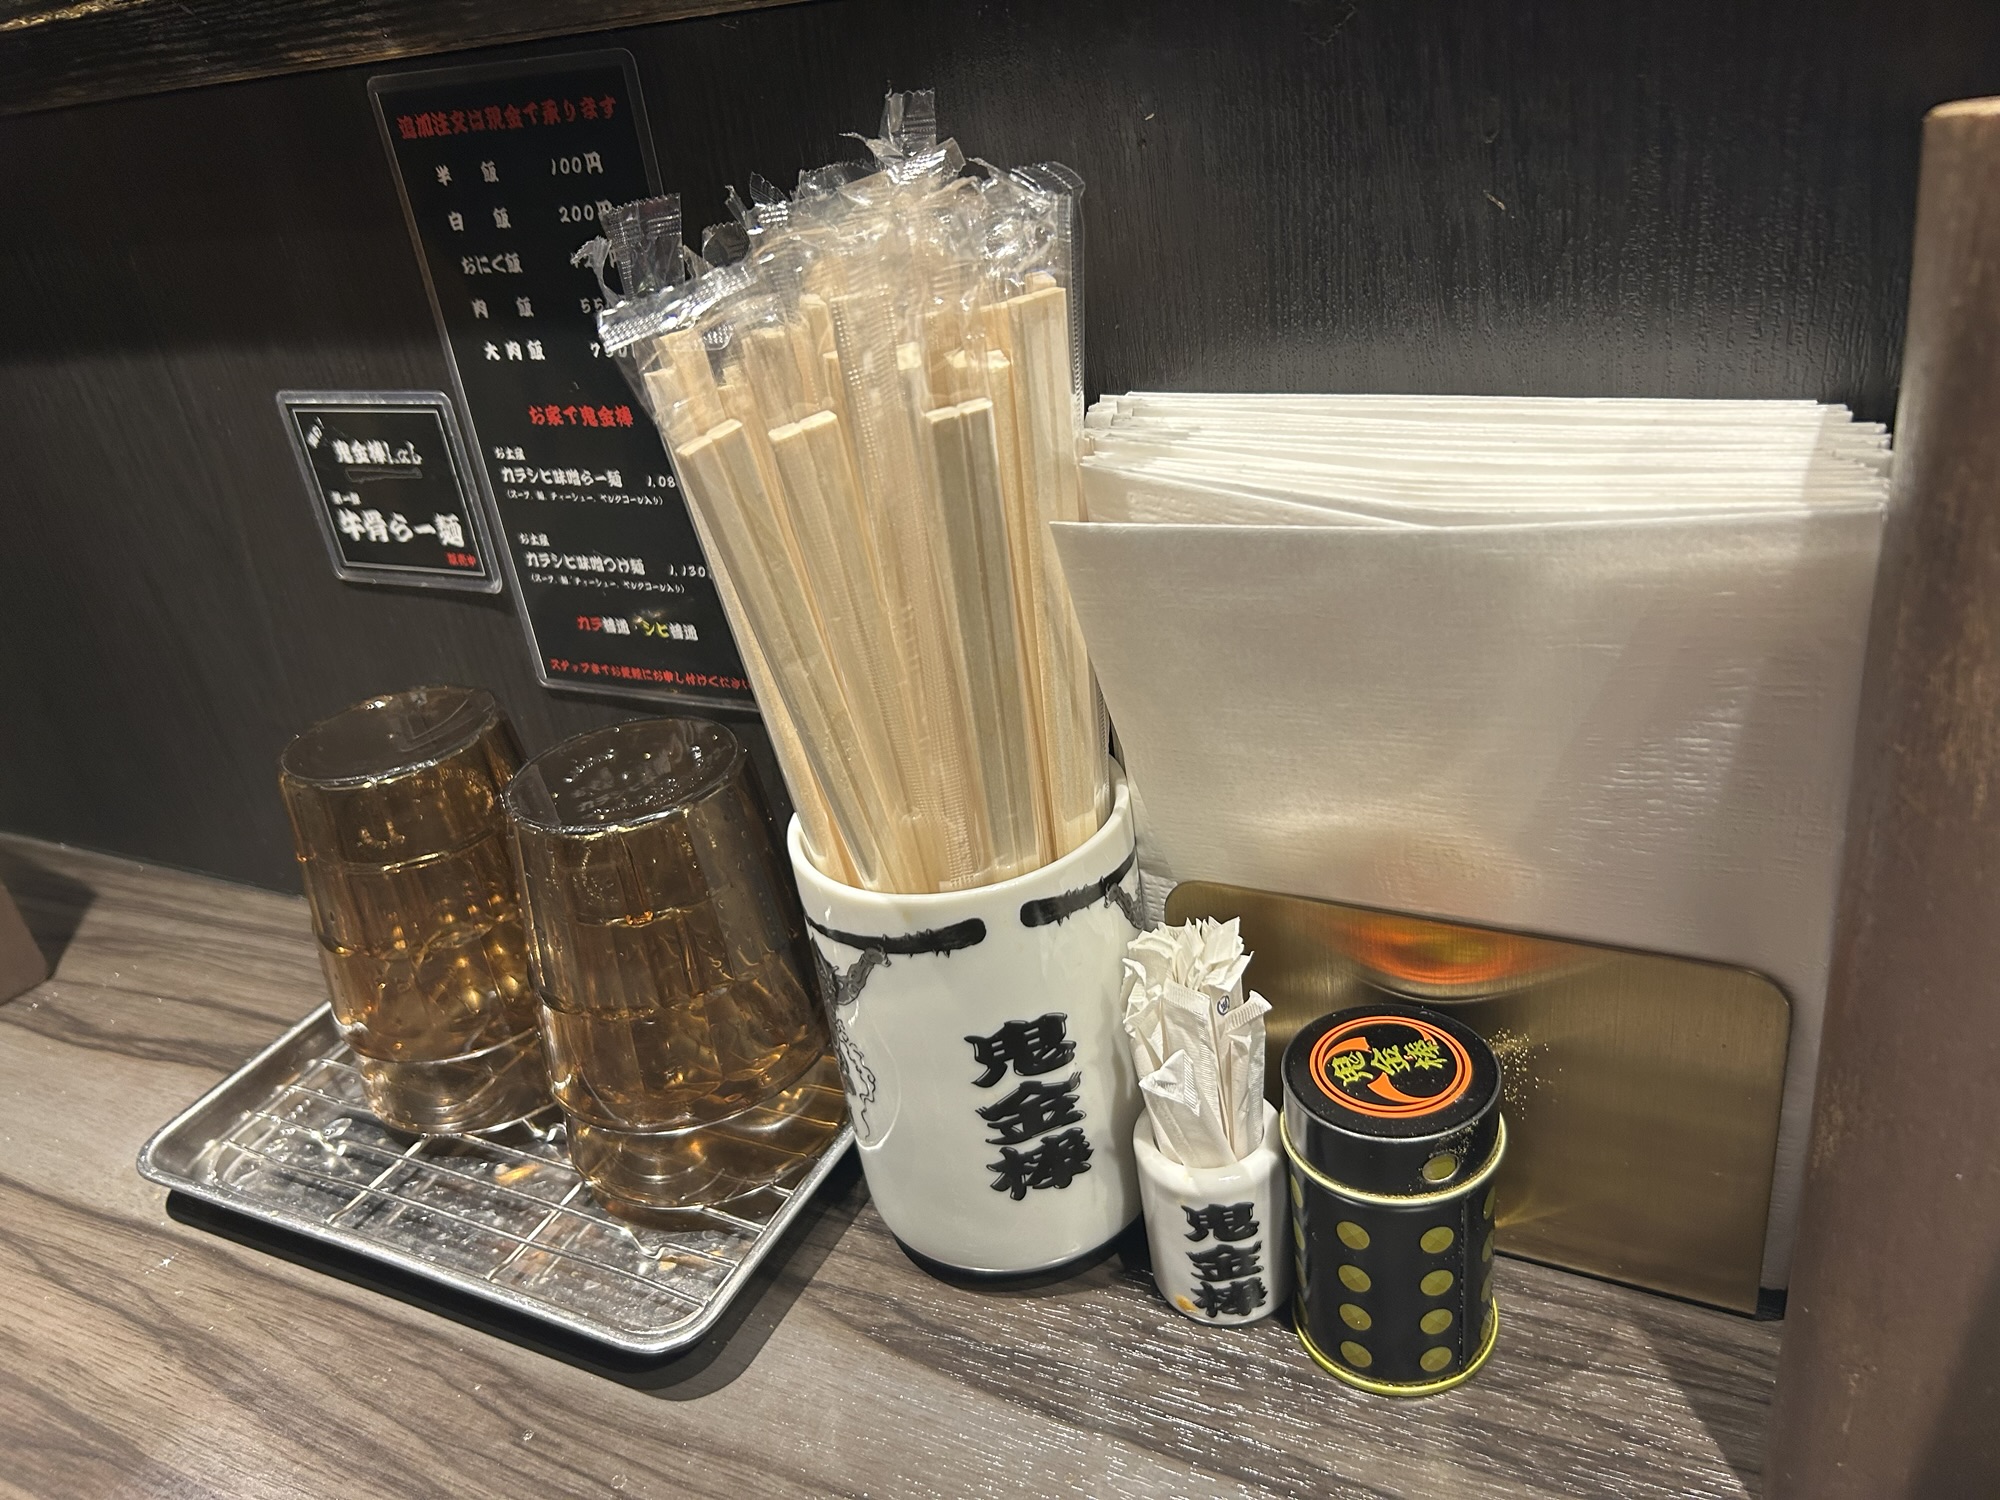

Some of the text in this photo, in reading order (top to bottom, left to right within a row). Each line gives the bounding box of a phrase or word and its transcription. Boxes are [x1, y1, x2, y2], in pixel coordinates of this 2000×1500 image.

[551, 151, 604, 176] 100円
[646, 475, 677, 489] 1,08
[1330, 1038, 1449, 1088] 鬼金棒
[962, 1012, 1095, 1201] 鬼金棒
[1179, 1201, 1268, 1318] 鬼金棒
